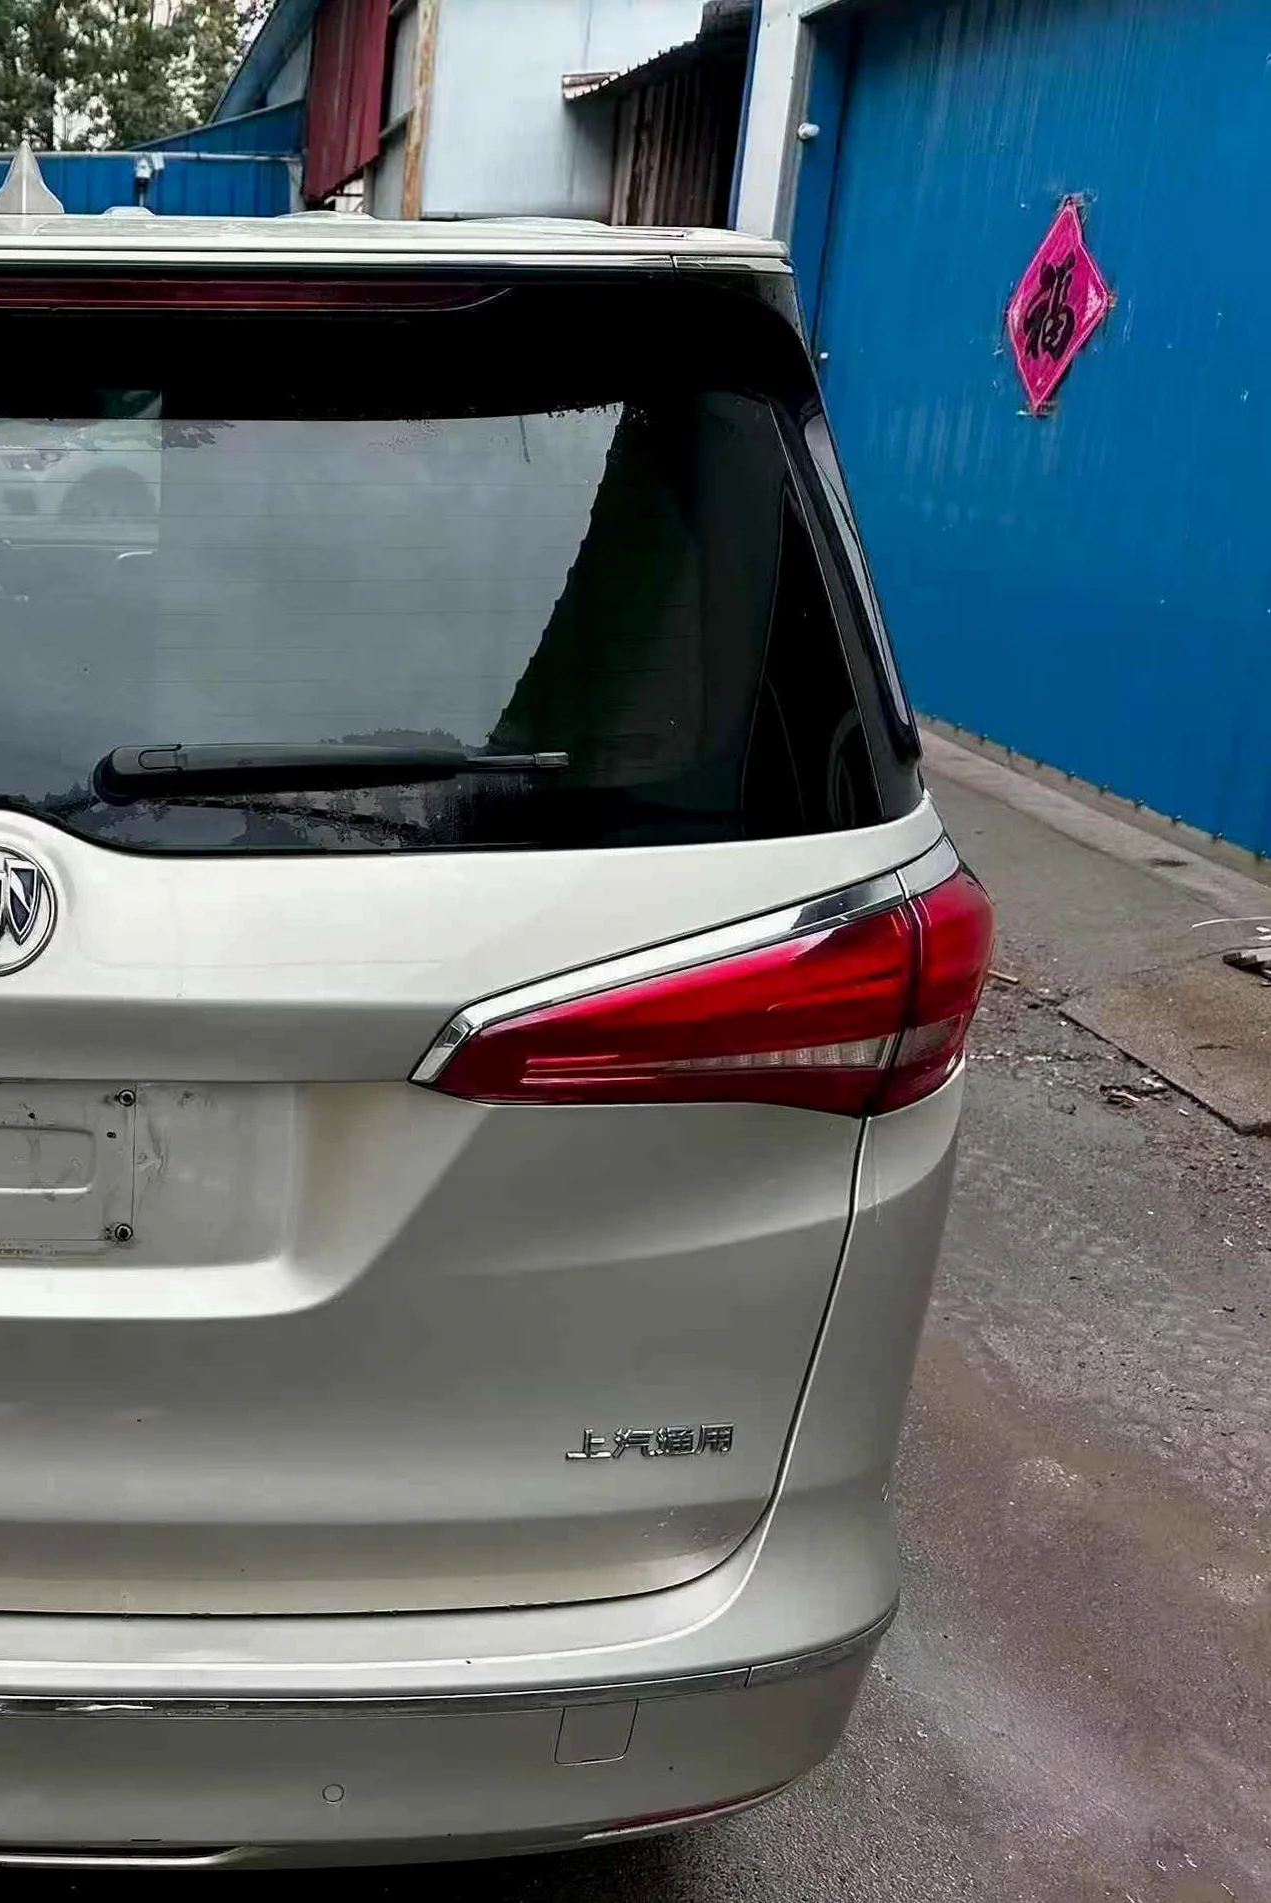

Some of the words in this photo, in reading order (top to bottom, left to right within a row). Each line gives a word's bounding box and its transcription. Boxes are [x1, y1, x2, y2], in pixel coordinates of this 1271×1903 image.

[1023, 250, 1076, 361] 福
[566, 1423, 734, 1460] 上汽通用
